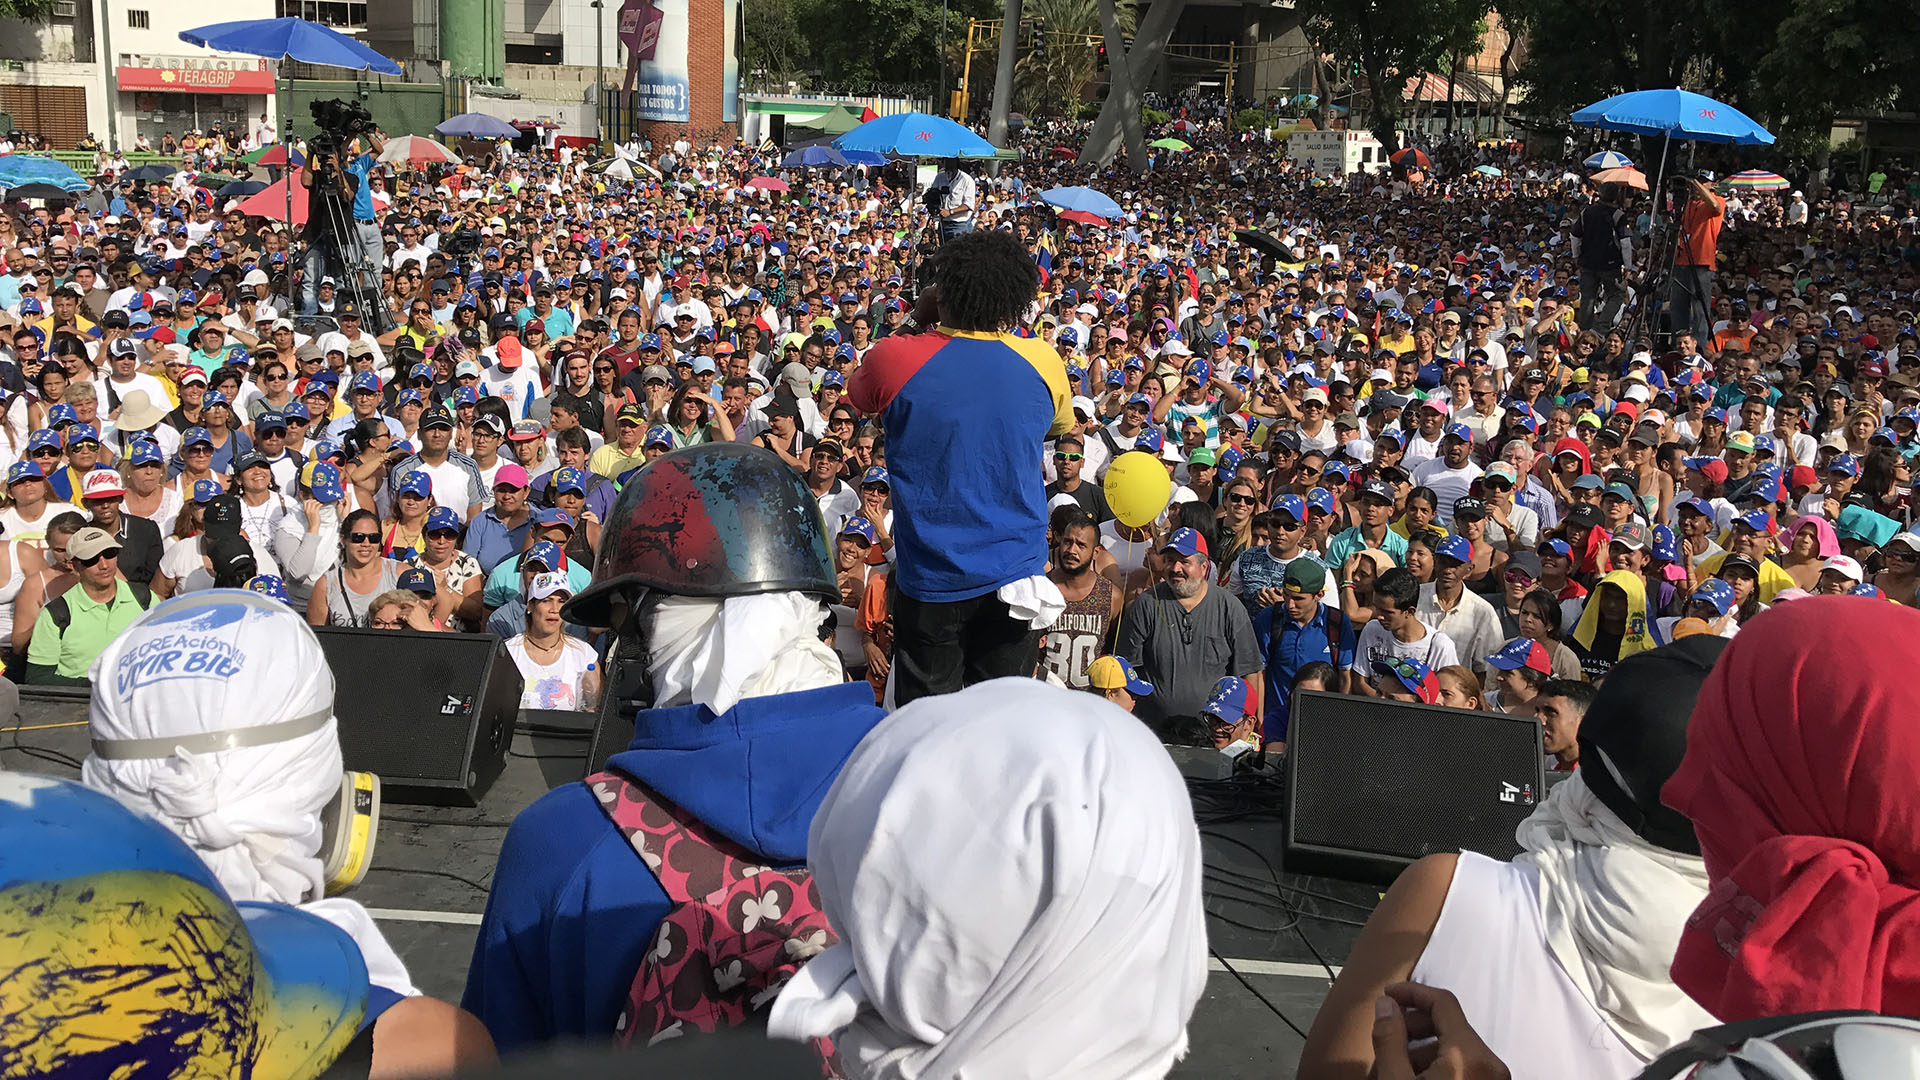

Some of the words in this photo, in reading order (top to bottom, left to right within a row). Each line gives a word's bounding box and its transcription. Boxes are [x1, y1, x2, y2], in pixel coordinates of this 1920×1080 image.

[138, 56, 251, 71] FARMACIA
[178, 70, 235, 84] TERAGRIP
[652, 84, 676, 96] TODOS
[648, 98, 675, 109] GUSTOS
[117, 650, 183, 695] VIVIR
[183, 650, 241, 677] BIE
[441, 694, 462, 714] EV
[1499, 780, 1520, 803] EV
